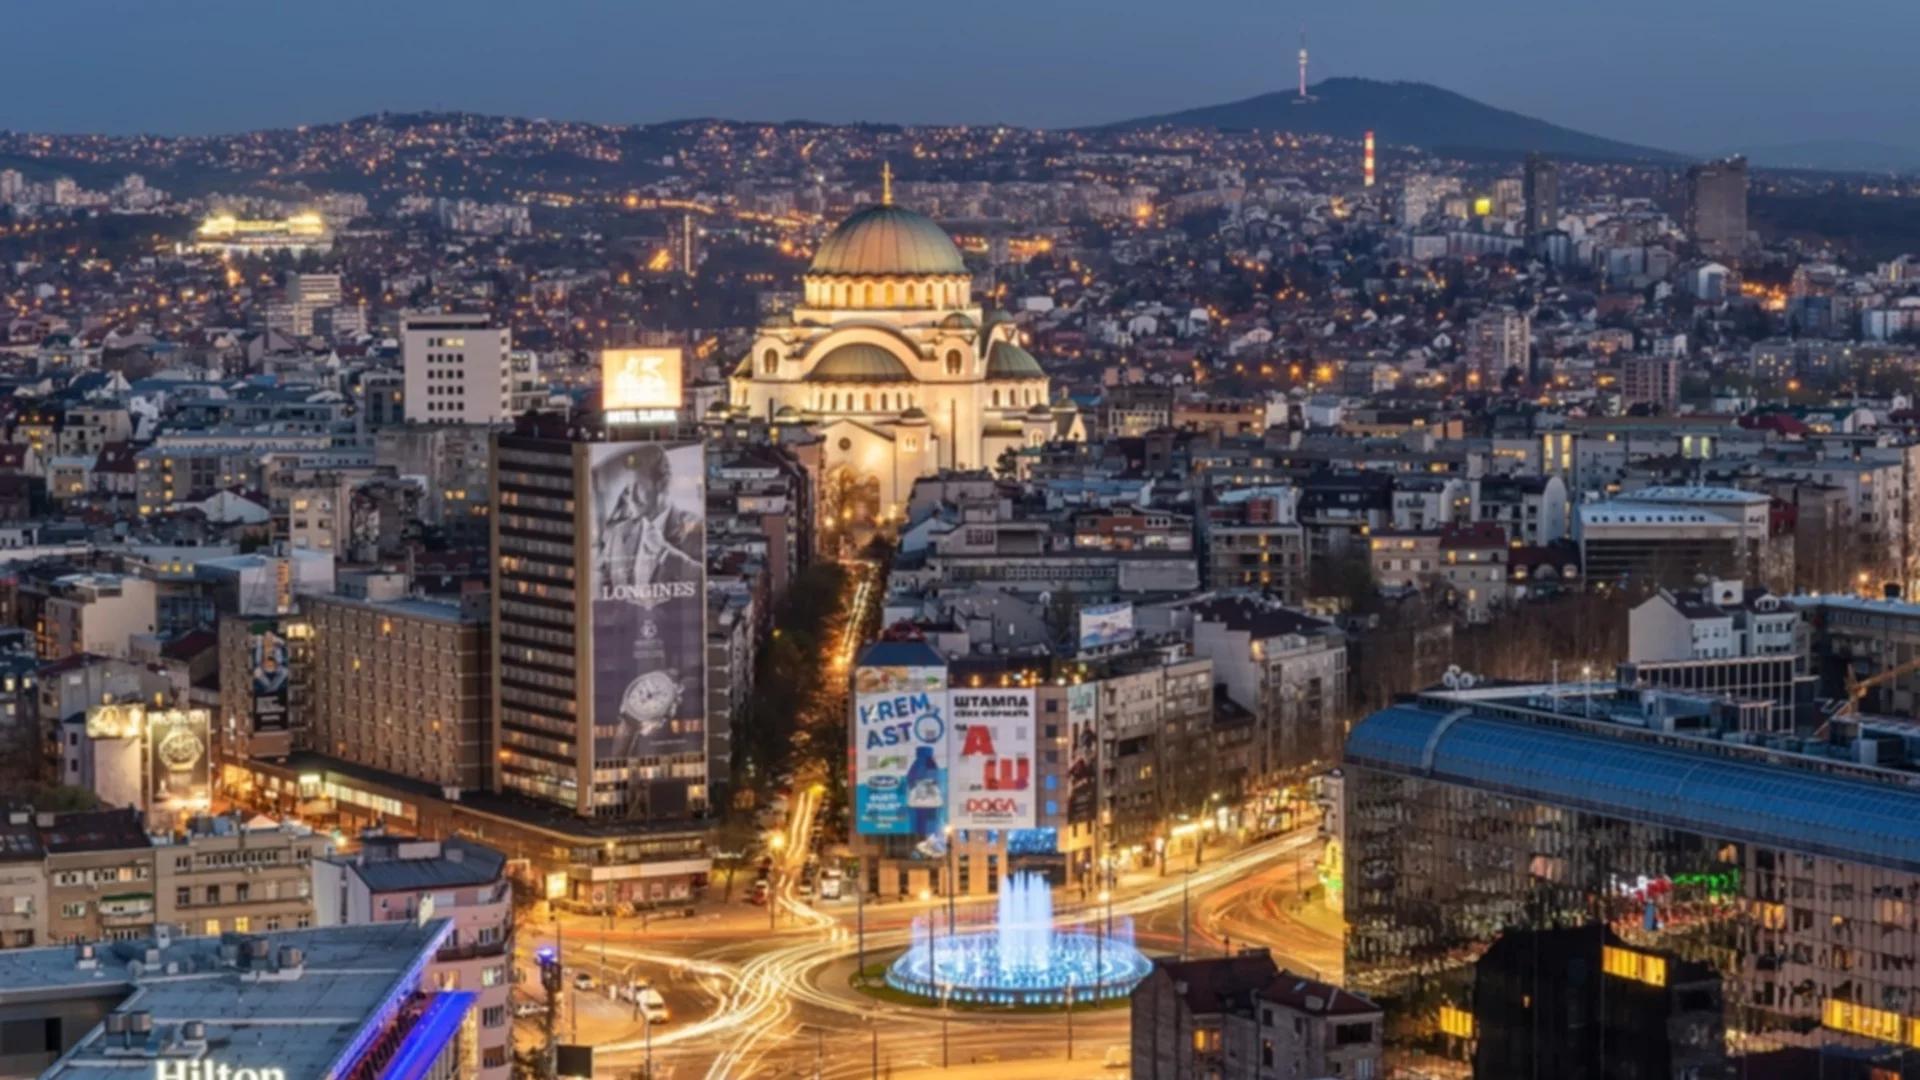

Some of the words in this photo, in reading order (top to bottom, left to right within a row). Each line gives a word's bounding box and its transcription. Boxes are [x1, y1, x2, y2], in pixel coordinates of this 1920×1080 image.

[603, 581, 696, 600] LONGINES
[954, 695, 1029, 707] ШТАМПА
[985, 757, 1030, 791] Ш
[966, 797, 1017, 813] DOGA
